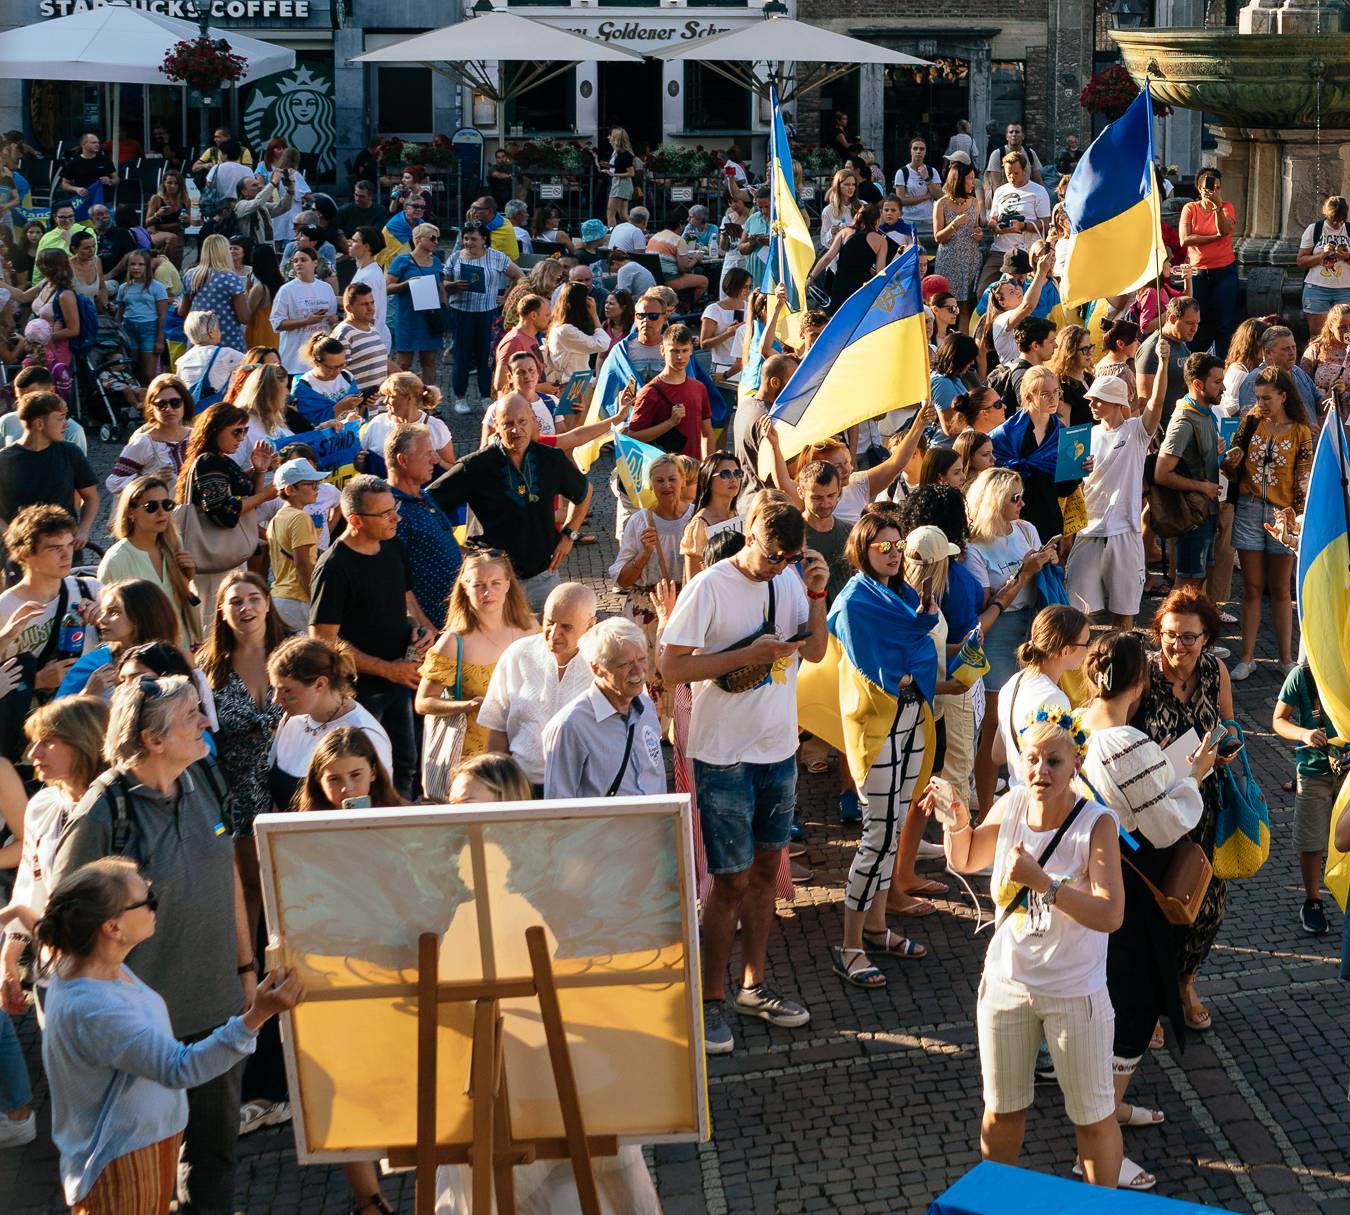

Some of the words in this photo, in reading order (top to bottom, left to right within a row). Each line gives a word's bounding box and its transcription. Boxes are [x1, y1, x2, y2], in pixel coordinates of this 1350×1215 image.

[40, 0, 201, 17] STARUCKS
[211, 0, 309, 18] COFFEE
[598, 21, 676, 41] Goldener
[318, 430, 355, 458] STAND
